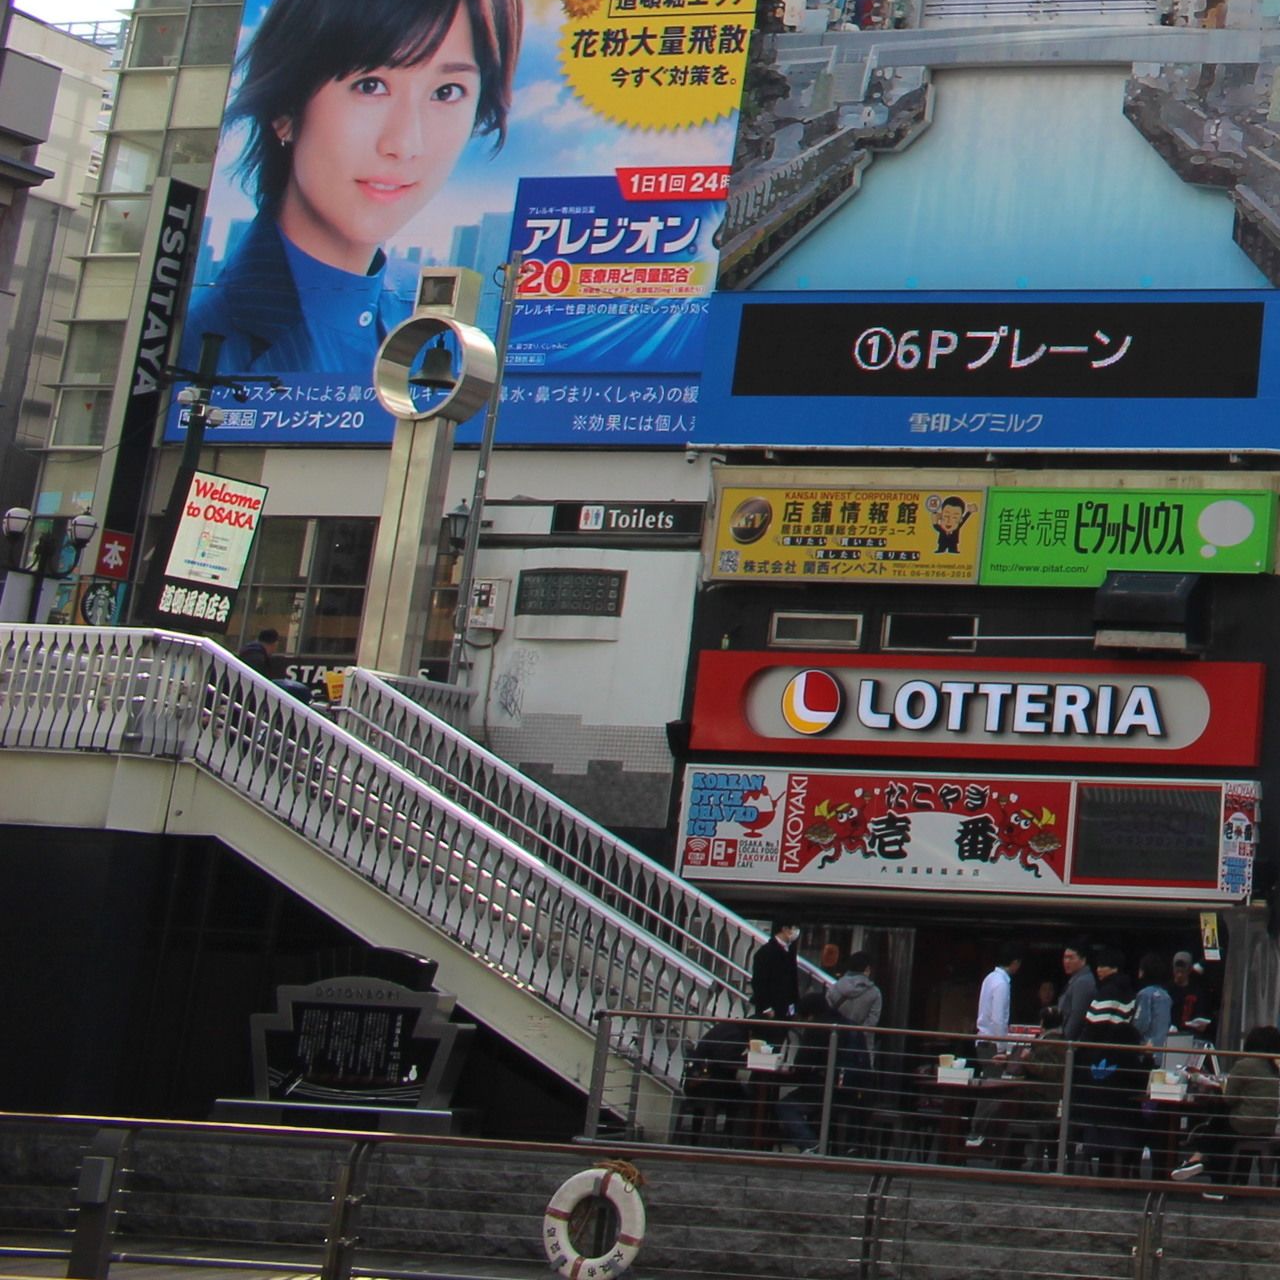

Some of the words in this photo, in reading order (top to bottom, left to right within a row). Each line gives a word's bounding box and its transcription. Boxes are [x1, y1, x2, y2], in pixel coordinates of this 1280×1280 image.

[611, 65, 737, 88] 今すぐ対策を。
[522, 217, 700, 255] アレジオン
[518, 259, 571, 294] 20
[579, 268, 690, 286] 医療用と同量配合
[133, 203, 192, 397] TSUTAYA
[260, 411, 364, 429] アレジオン20
[572, 414, 696, 433] ※効果には個人
[907, 412, 1044, 434] 雪印メグミルク
[195, 479, 261, 510] Welcome
[186, 501, 201, 518] to
[203, 505, 254, 530] OSAKA
[608, 508, 674, 531] Toilets
[782, 501, 919, 524] 店舗情報館
[996, 507, 1070, 547] 賃貸・売買
[1074, 500, 1185, 555] ピタットハウス
[857, 679, 1165, 736] LOTTERIA
[692, 772, 765, 791] KOREAN
[690, 790, 744, 806] STYLE
[885, 780, 990, 811] たこやき
[688, 805, 759, 822] SHAVED
[783, 776, 808, 871] TAKOYAKI
[687, 820, 717, 837] ICE
